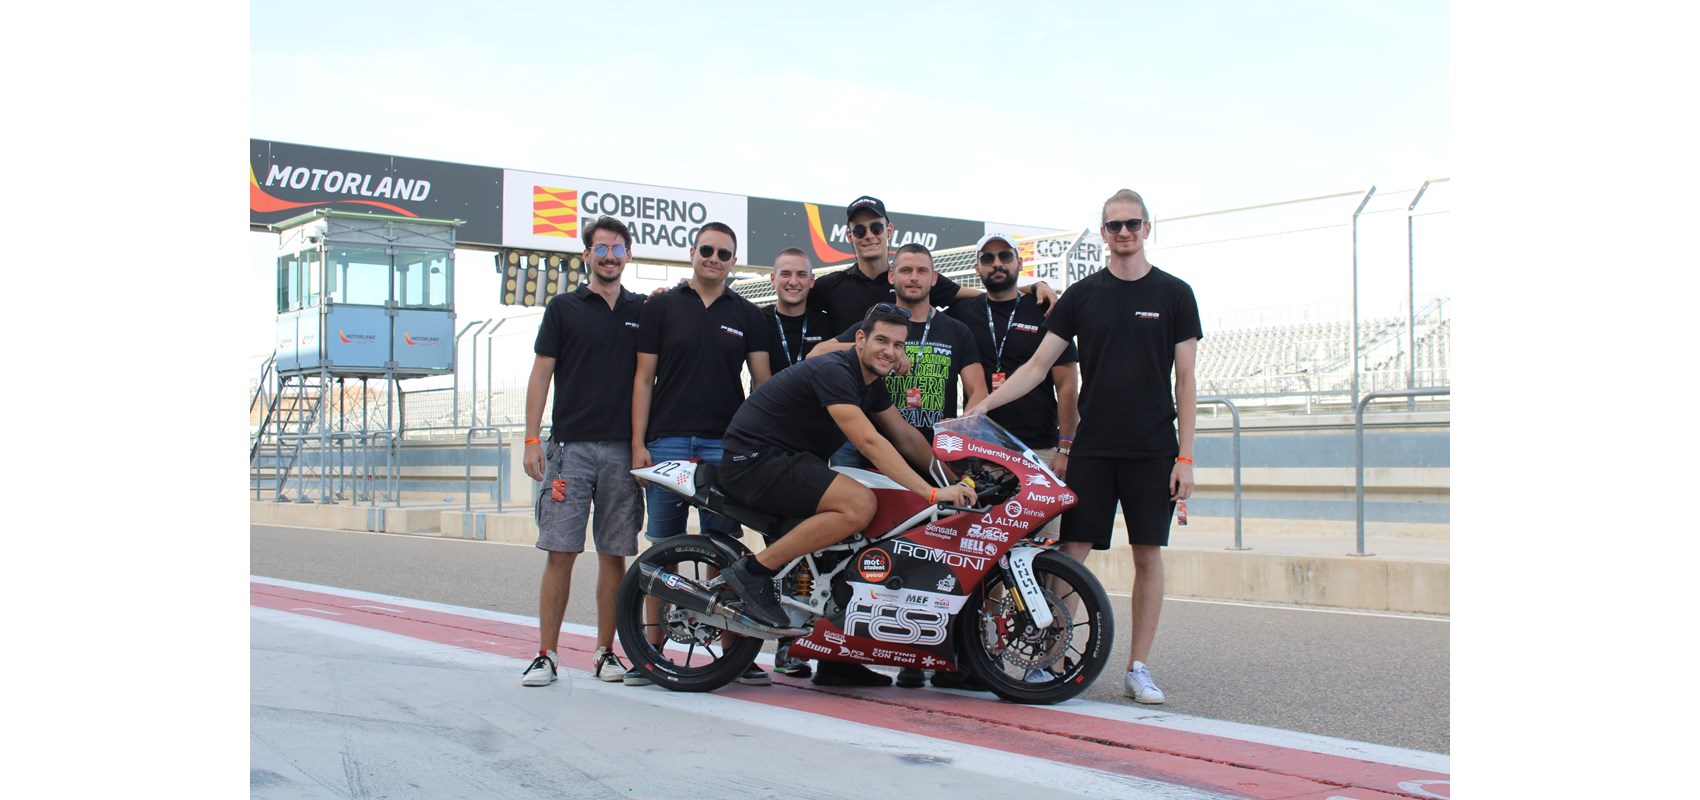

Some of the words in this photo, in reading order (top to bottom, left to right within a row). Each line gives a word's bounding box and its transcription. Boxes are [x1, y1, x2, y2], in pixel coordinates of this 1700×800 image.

[265, 164, 431, 202] MOTORLAND
[580, 190, 707, 224] GOBIERNO
[967, 443, 1011, 461] University
[652, 461, 681, 477] 22
[1027, 491, 1056, 504] Ansys
[1008, 505, 1020, 513] PS
[1023, 507, 1046, 518] Tehnik
[925, 523, 958, 536] Sensata
[995, 517, 1029, 529] ALTAIR
[924, 530, 951, 540] Technologies
[960, 537, 984, 552] HELL
[890, 539, 991, 571] TROMONT
[864, 558, 885, 566] moto
[905, 594, 929, 604] MEF
[795, 637, 832, 655] Altium
[873, 647, 917, 658] SHIFTING
[872, 651, 891, 659] CON
